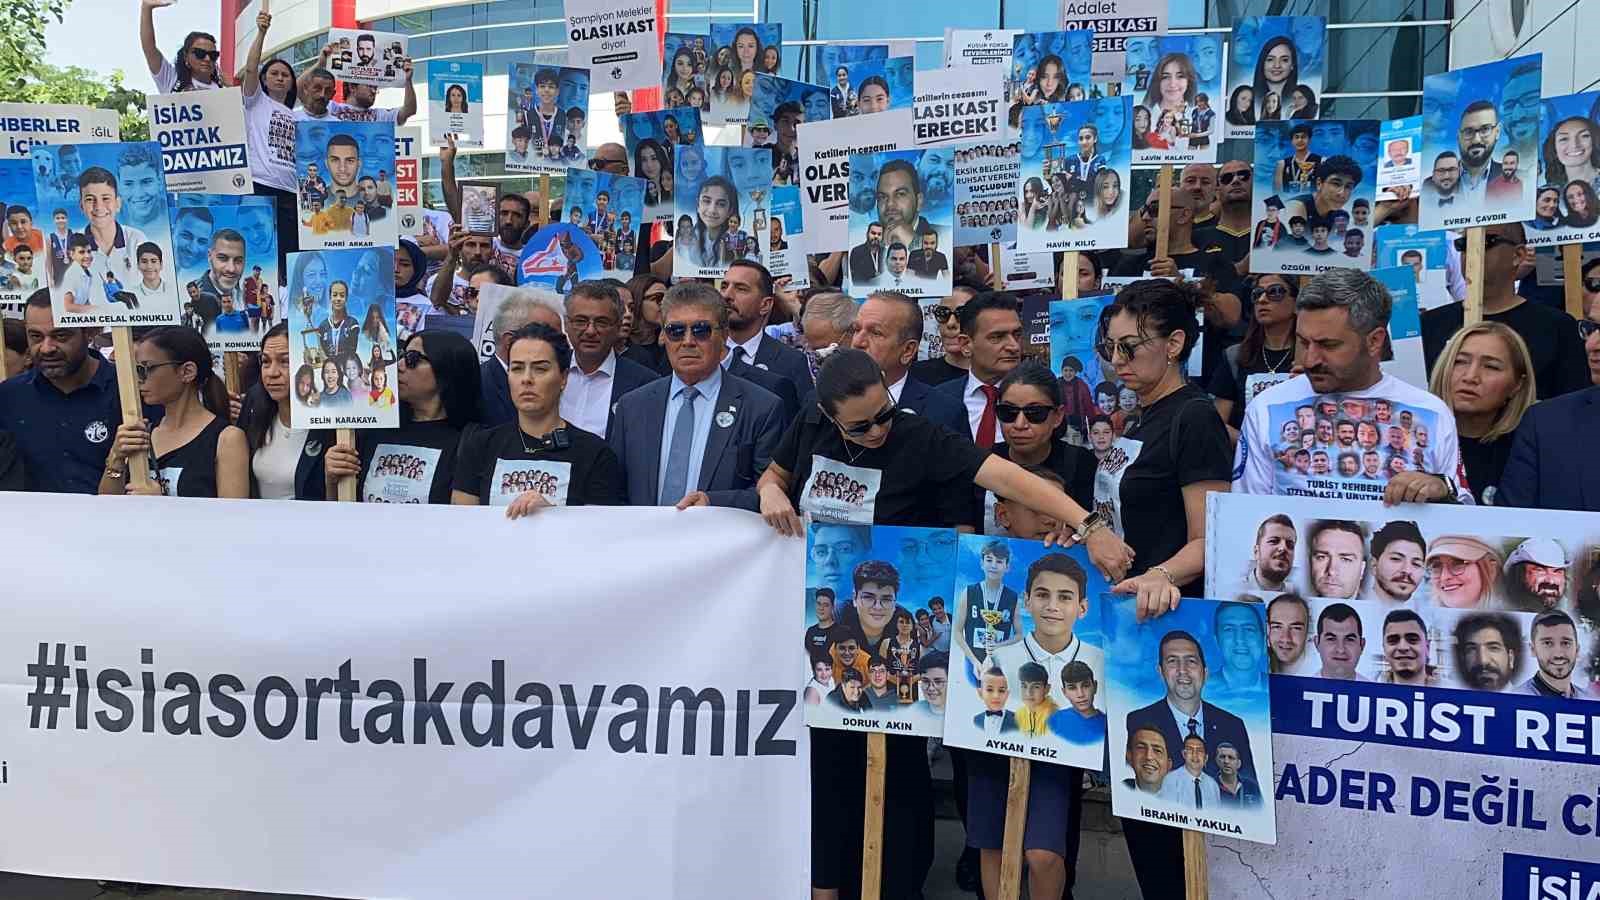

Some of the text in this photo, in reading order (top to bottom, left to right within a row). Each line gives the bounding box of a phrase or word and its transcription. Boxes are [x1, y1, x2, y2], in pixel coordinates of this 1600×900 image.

[570, 7, 652, 26] Şampiyon Melekler
[1067, 2, 1116, 15] Adalet
[570, 18, 654, 41] OLASI KAST
[1114, 18, 1156, 32] KAST
[154, 103, 203, 124] İSİAS
[952, 100, 998, 116] KAST
[913, 116, 996, 138] ERECEK!
[158, 126, 222, 148] ORTAK
[162, 148, 244, 171] DAVAMIZ
[814, 146, 856, 160] Katillerin
[956, 176, 986, 184] RUHSAT
[1444, 214, 1508, 226] EVREN ÇAVDIR
[1046, 240, 1096, 248] HAVİN KILIÇ
[60, 314, 173, 324] ATAKAN CELAL KONUKLU
[310, 415, 378, 424] SELİN KARAKAYA
[1306, 480, 1339, 489] TURİST
[27, 642, 797, 756] #isiasortakdavamız
[842, 717, 912, 730] DORUK AKIN
[1304, 691, 1496, 745] TURİST
[986, 739, 1057, 758] AYKAN EKİZ
[1410, 774, 1547, 831] DEĞİL
[1140, 805, 1243, 834] İBRAHİM YAKULA
